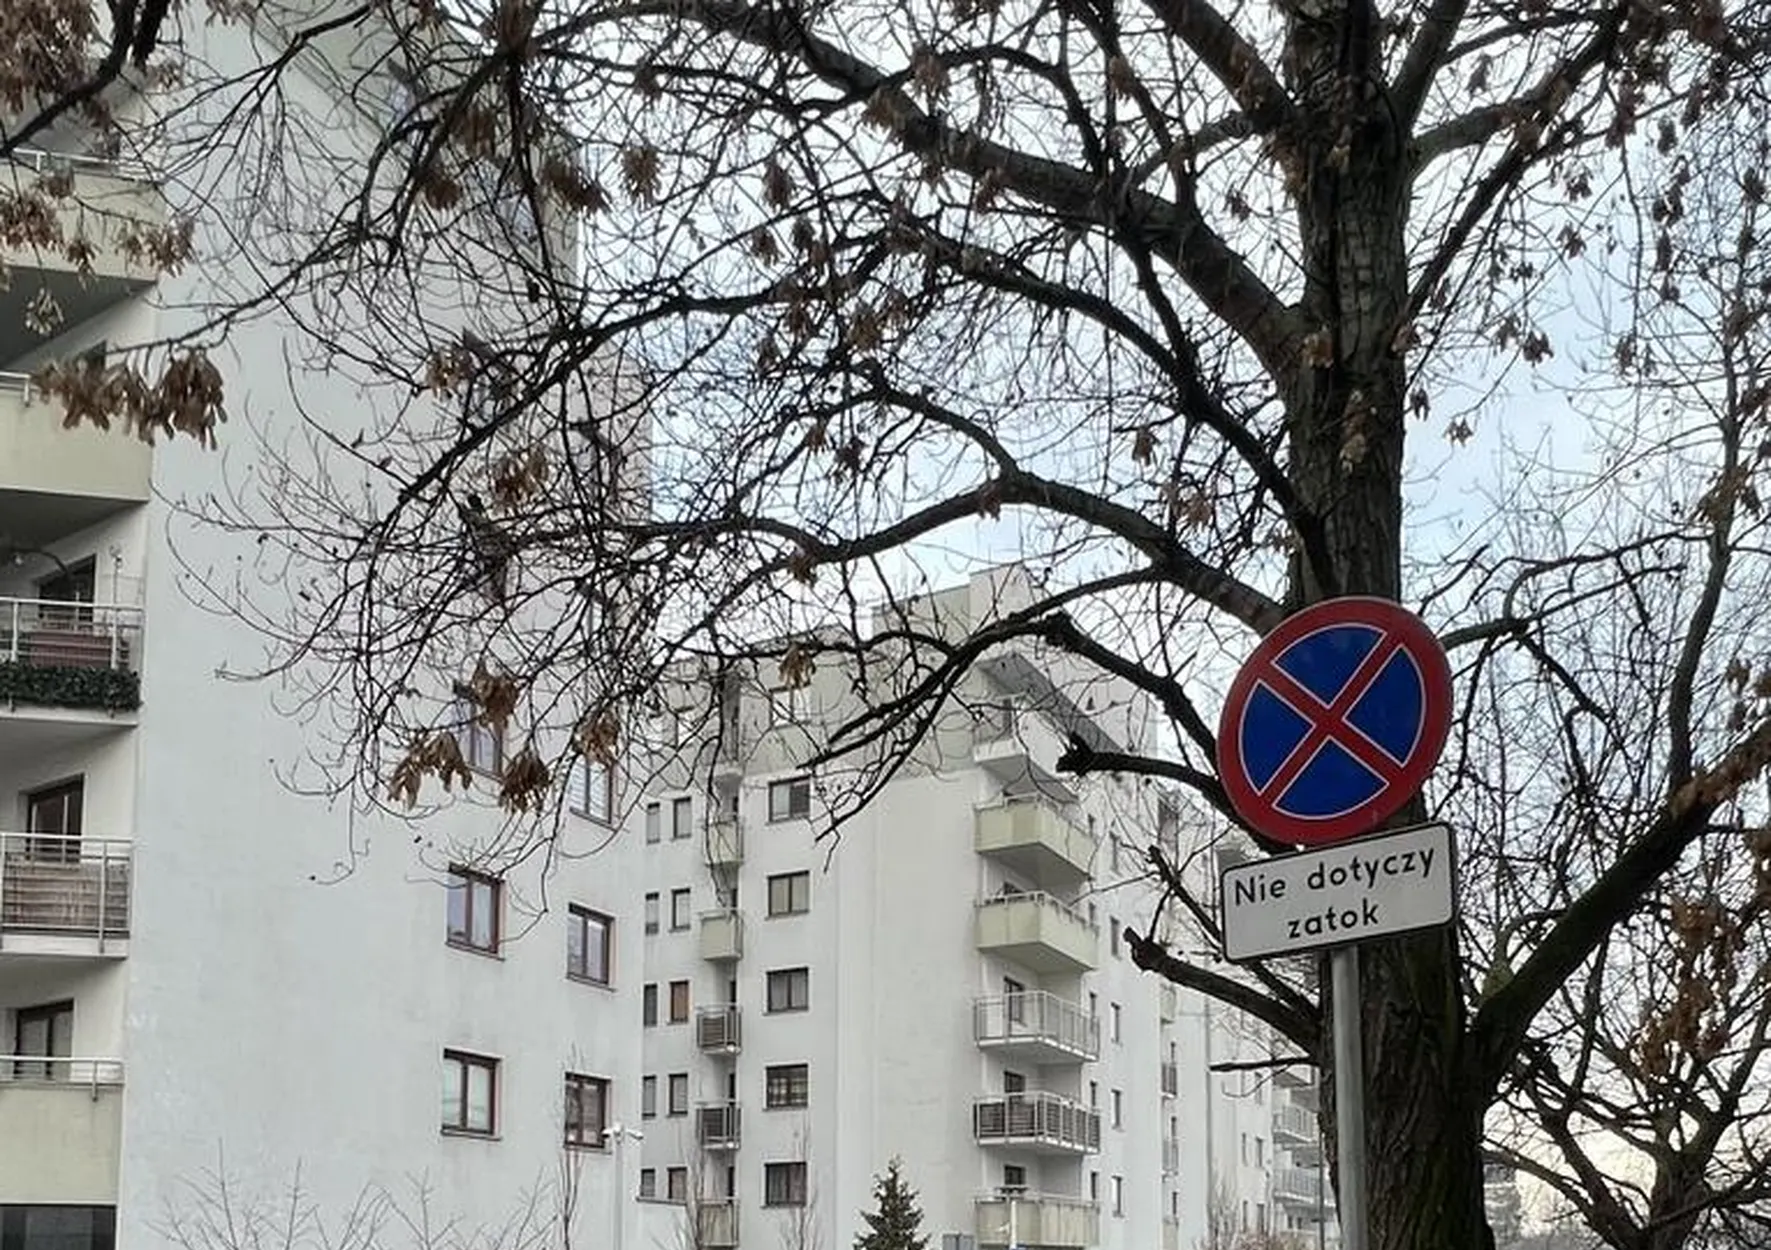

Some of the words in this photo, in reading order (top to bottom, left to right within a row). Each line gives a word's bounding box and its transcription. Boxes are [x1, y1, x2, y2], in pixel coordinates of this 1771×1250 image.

[1235, 874, 1286, 905] Nie
[1307, 848, 1435, 888] dotyczy
[1288, 898, 1379, 938] zatok
